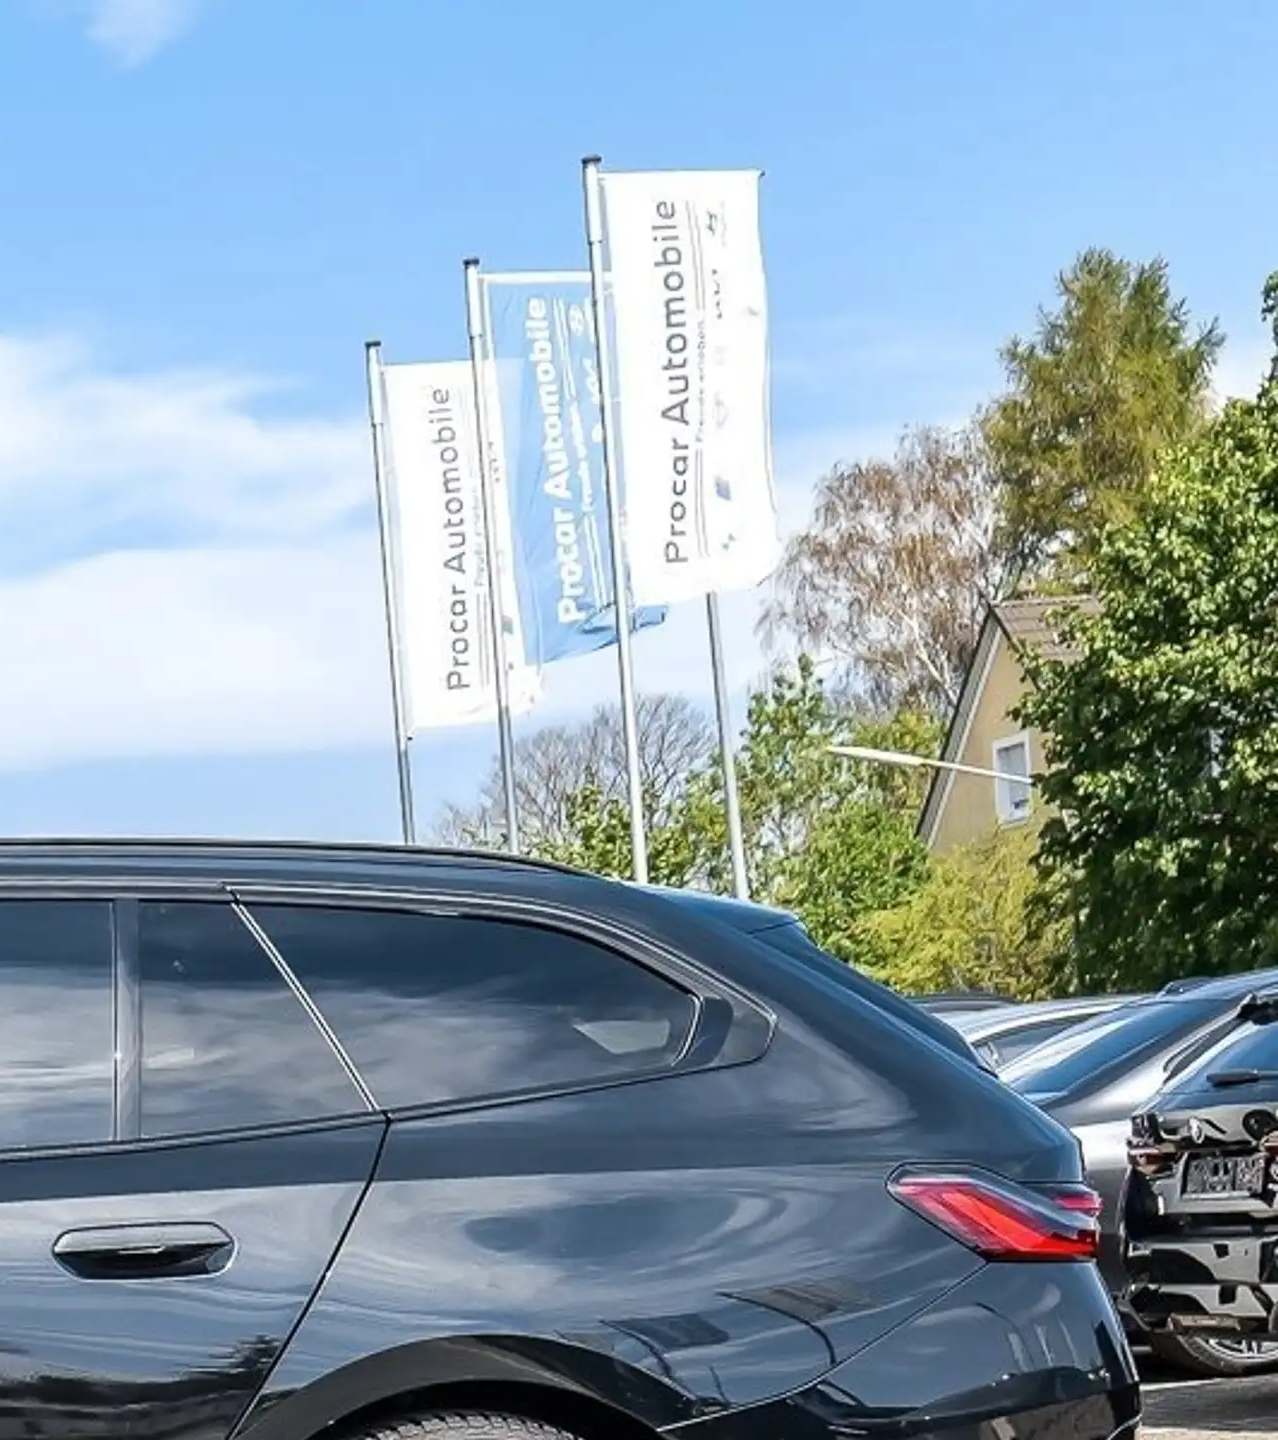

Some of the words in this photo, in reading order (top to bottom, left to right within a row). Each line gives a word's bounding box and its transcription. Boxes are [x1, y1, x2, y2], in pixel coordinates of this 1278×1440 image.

[652, 200, 689, 425] Automobile
[526, 297, 572, 498] Automobile
[428, 388, 466, 574] Automobile
[665, 438, 689, 563] Procar
[446, 584, 470, 690] Procar
[554, 507, 586, 624] Procar
